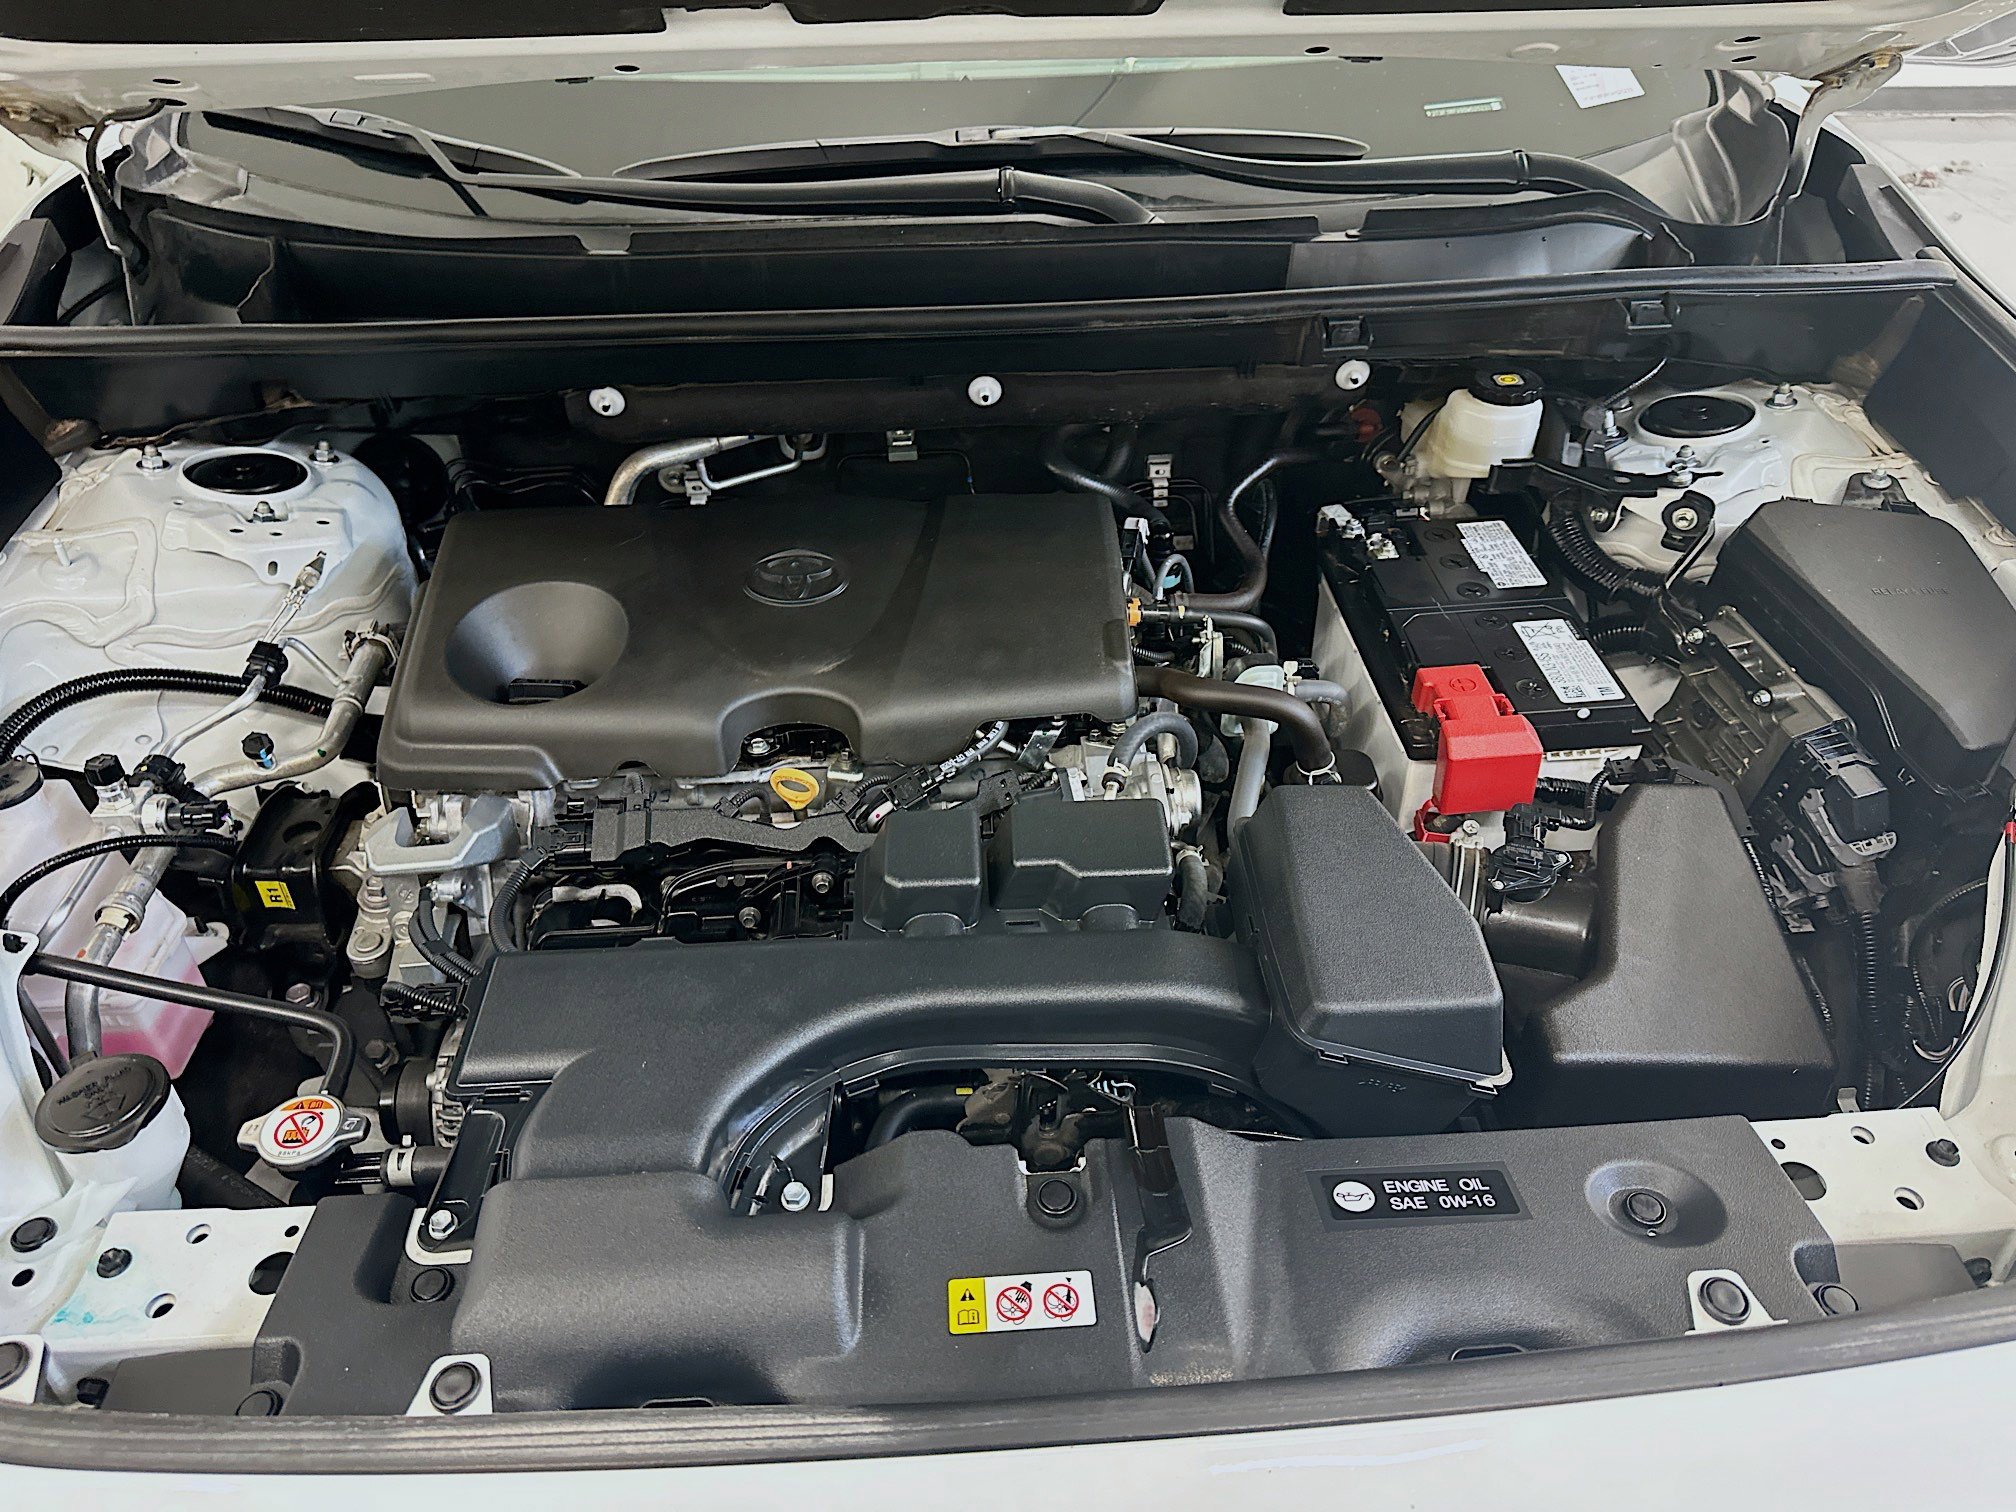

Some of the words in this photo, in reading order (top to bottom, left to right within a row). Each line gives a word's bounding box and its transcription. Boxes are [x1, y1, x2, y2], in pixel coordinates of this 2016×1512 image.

[267, 888, 283, 903] R1
[1382, 1179, 1450, 1194] ENGINE
[1458, 1177, 1490, 1192] OIL
[1389, 1196, 1429, 1210] SAE
[1439, 1194, 1496, 1209] 0W-16
